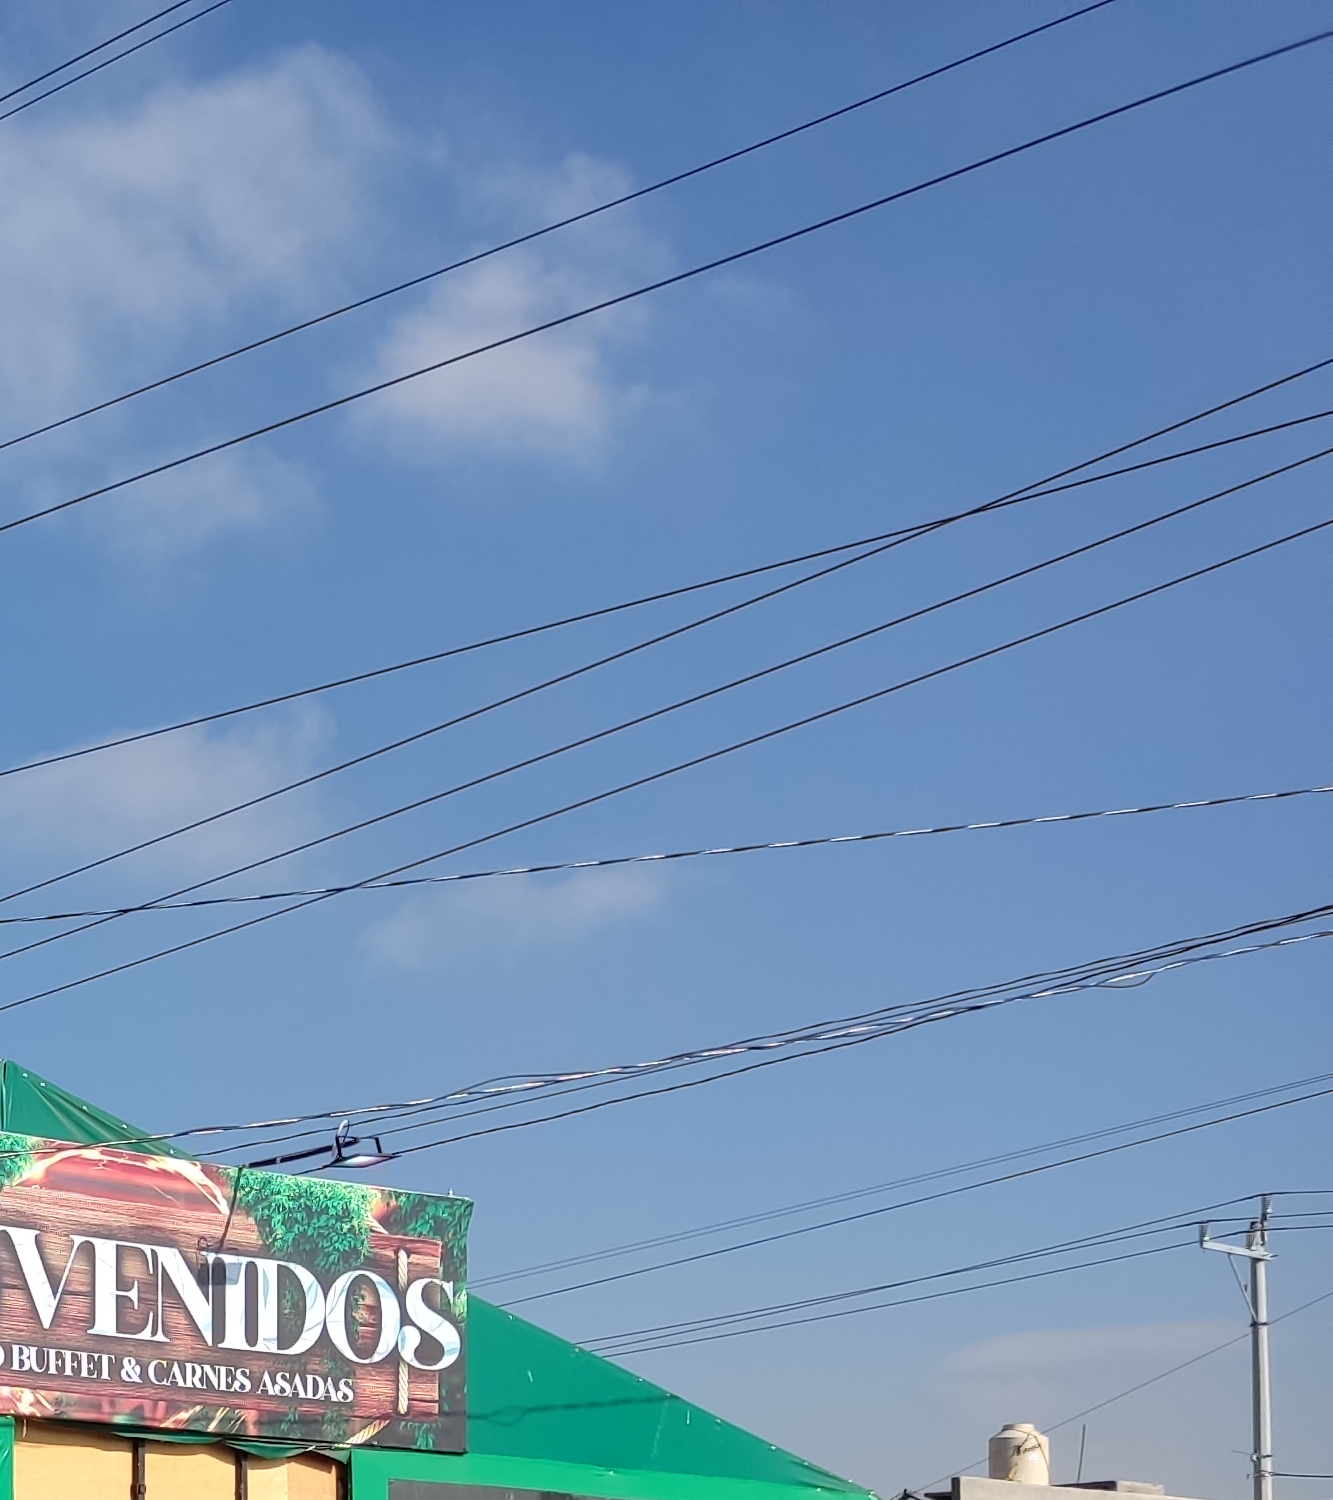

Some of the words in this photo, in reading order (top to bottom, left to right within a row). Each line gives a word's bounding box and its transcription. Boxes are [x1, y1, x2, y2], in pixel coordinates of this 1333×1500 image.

[11, 1344, 115, 1381] BUFFET
[120, 1361, 142, 1383] &
[148, 1359, 251, 1393] CARNES
[256, 1370, 354, 1403] ASADAS
